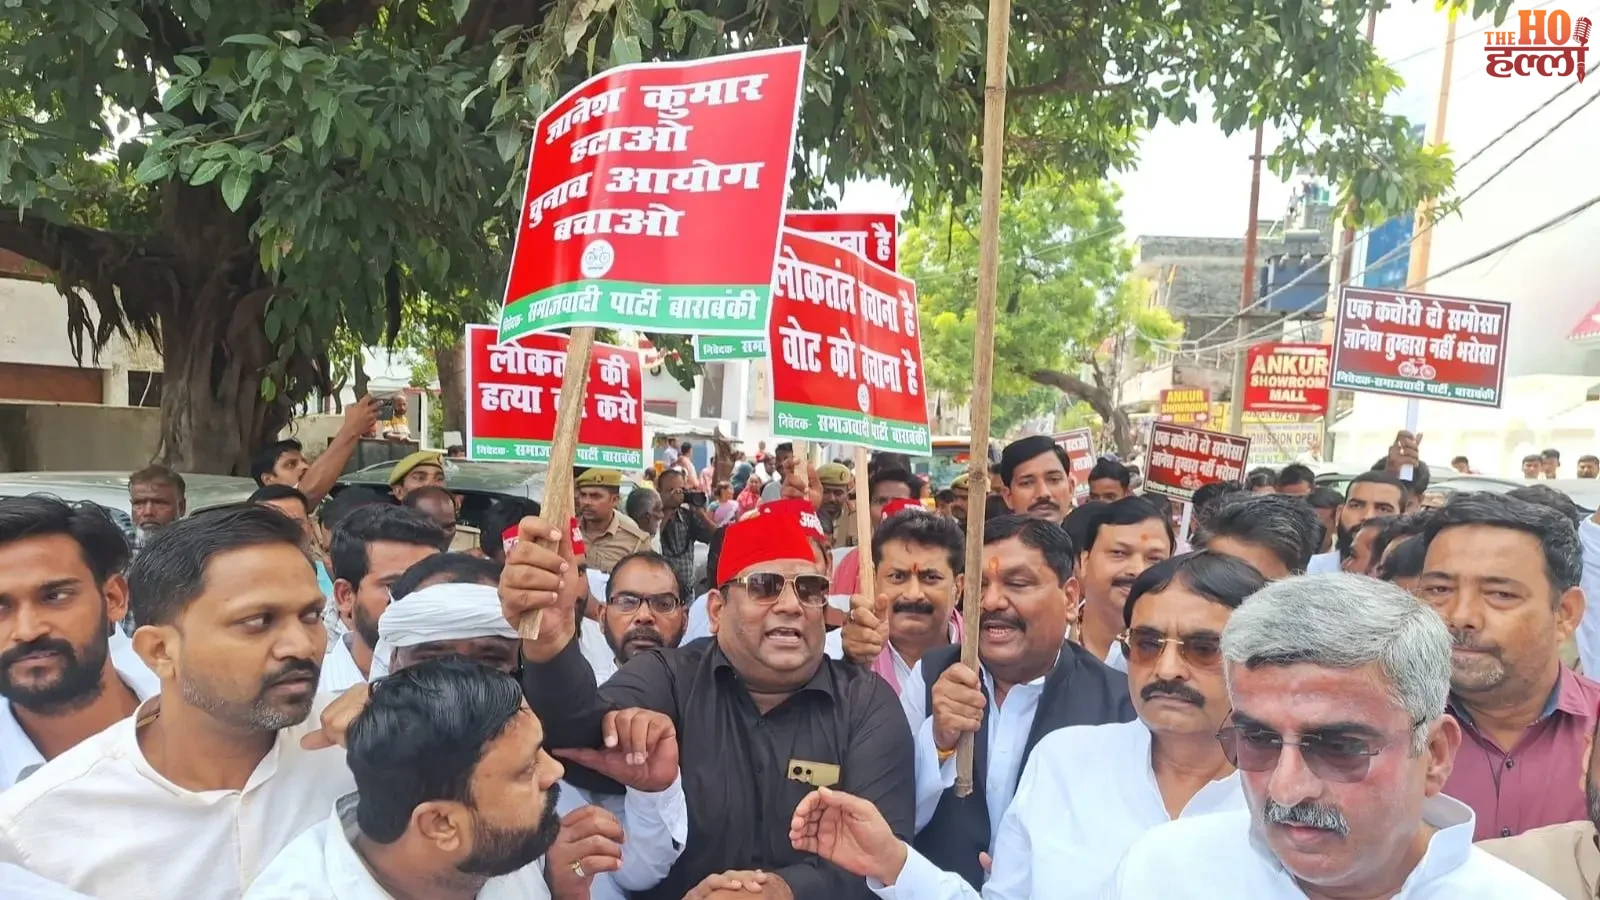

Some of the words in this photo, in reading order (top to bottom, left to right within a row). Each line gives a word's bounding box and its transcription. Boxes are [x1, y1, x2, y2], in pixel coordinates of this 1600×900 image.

[640, 74, 769, 118] कुमार
[570, 119, 693, 163] हटाओ
[529, 172, 593, 228] चुनाव
[606, 159, 765, 193] आयोग
[554, 203, 685, 241] बचाओ
[528, 285, 603, 323] समाजवादी
[609, 288, 661, 318] पार्टी
[669, 289, 760, 320] बाराबंकी
[858, 279, 900, 333] बचाना
[898, 288, 915, 337] है
[1346, 298, 1373, 320] एक
[1375, 297, 1423, 327] कचौरी
[1425, 301, 1445, 329] दो
[1448, 303, 1501, 335] समोसा
[779, 315, 821, 372] वोट
[827, 328, 857, 380] को
[860, 344, 902, 393] बचाना
[901, 348, 918, 396] है
[1250, 354, 1328, 376] ANKUR
[1429, 333, 1456, 361] नहीं
[1457, 336, 1498, 366] भरोसा
[597, 354, 631, 388] की
[1250, 375, 1325, 388] SHOWROOM
[478, 382, 543, 414] हत्या
[594, 390, 638, 424] करो
[1269, 389, 1307, 402] MALL
[817, 414, 870, 437] समाजवादी
[870, 421, 888, 441] पार्टी
[891, 426, 927, 446] बाराबंकी
